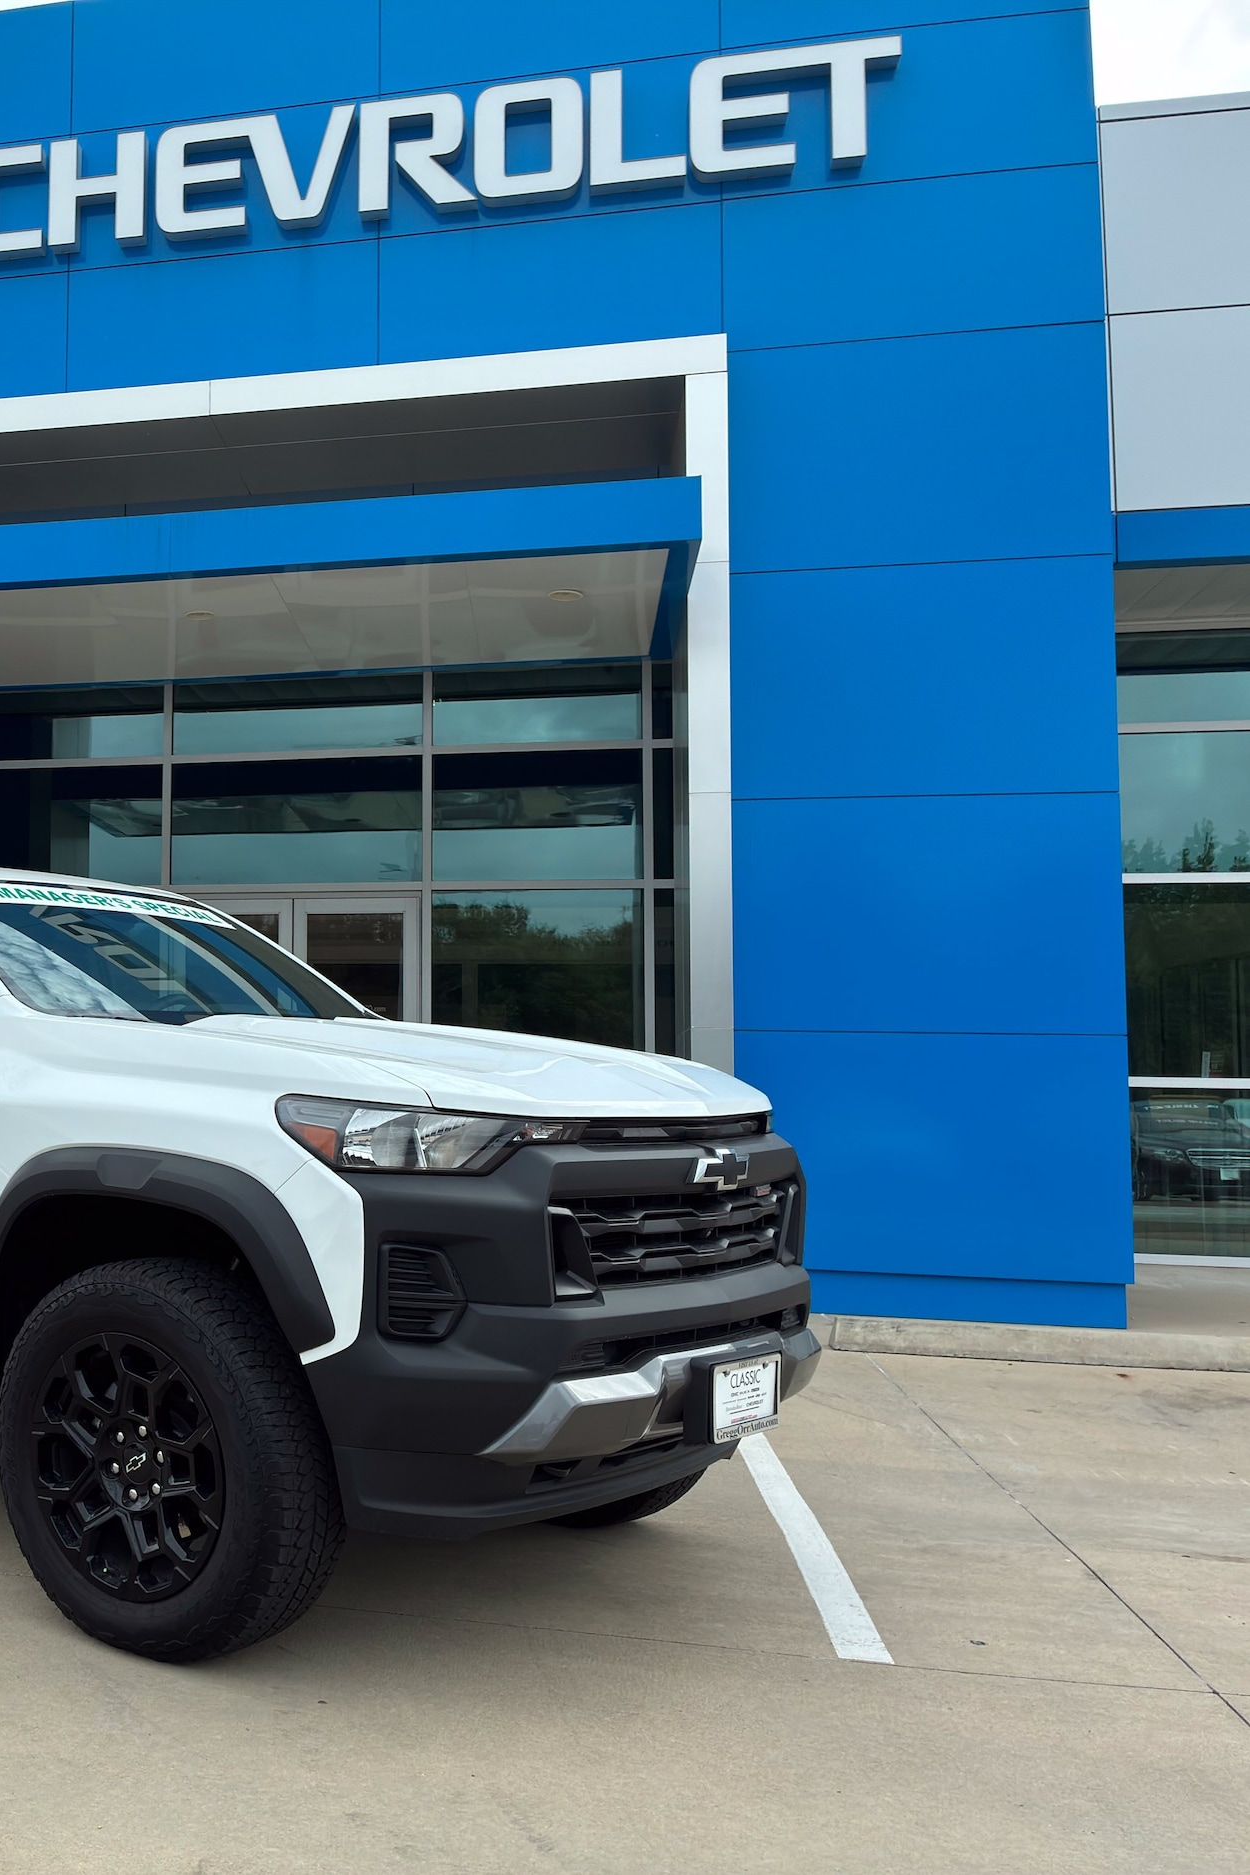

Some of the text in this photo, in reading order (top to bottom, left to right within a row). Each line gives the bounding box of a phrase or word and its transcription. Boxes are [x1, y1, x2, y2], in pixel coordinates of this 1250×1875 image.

[132, 899, 223, 924] SPECIAL
[730, 1368, 761, 1389] CLASSIC
[716, 1418, 778, 1441] GreggOrrAuto.com
